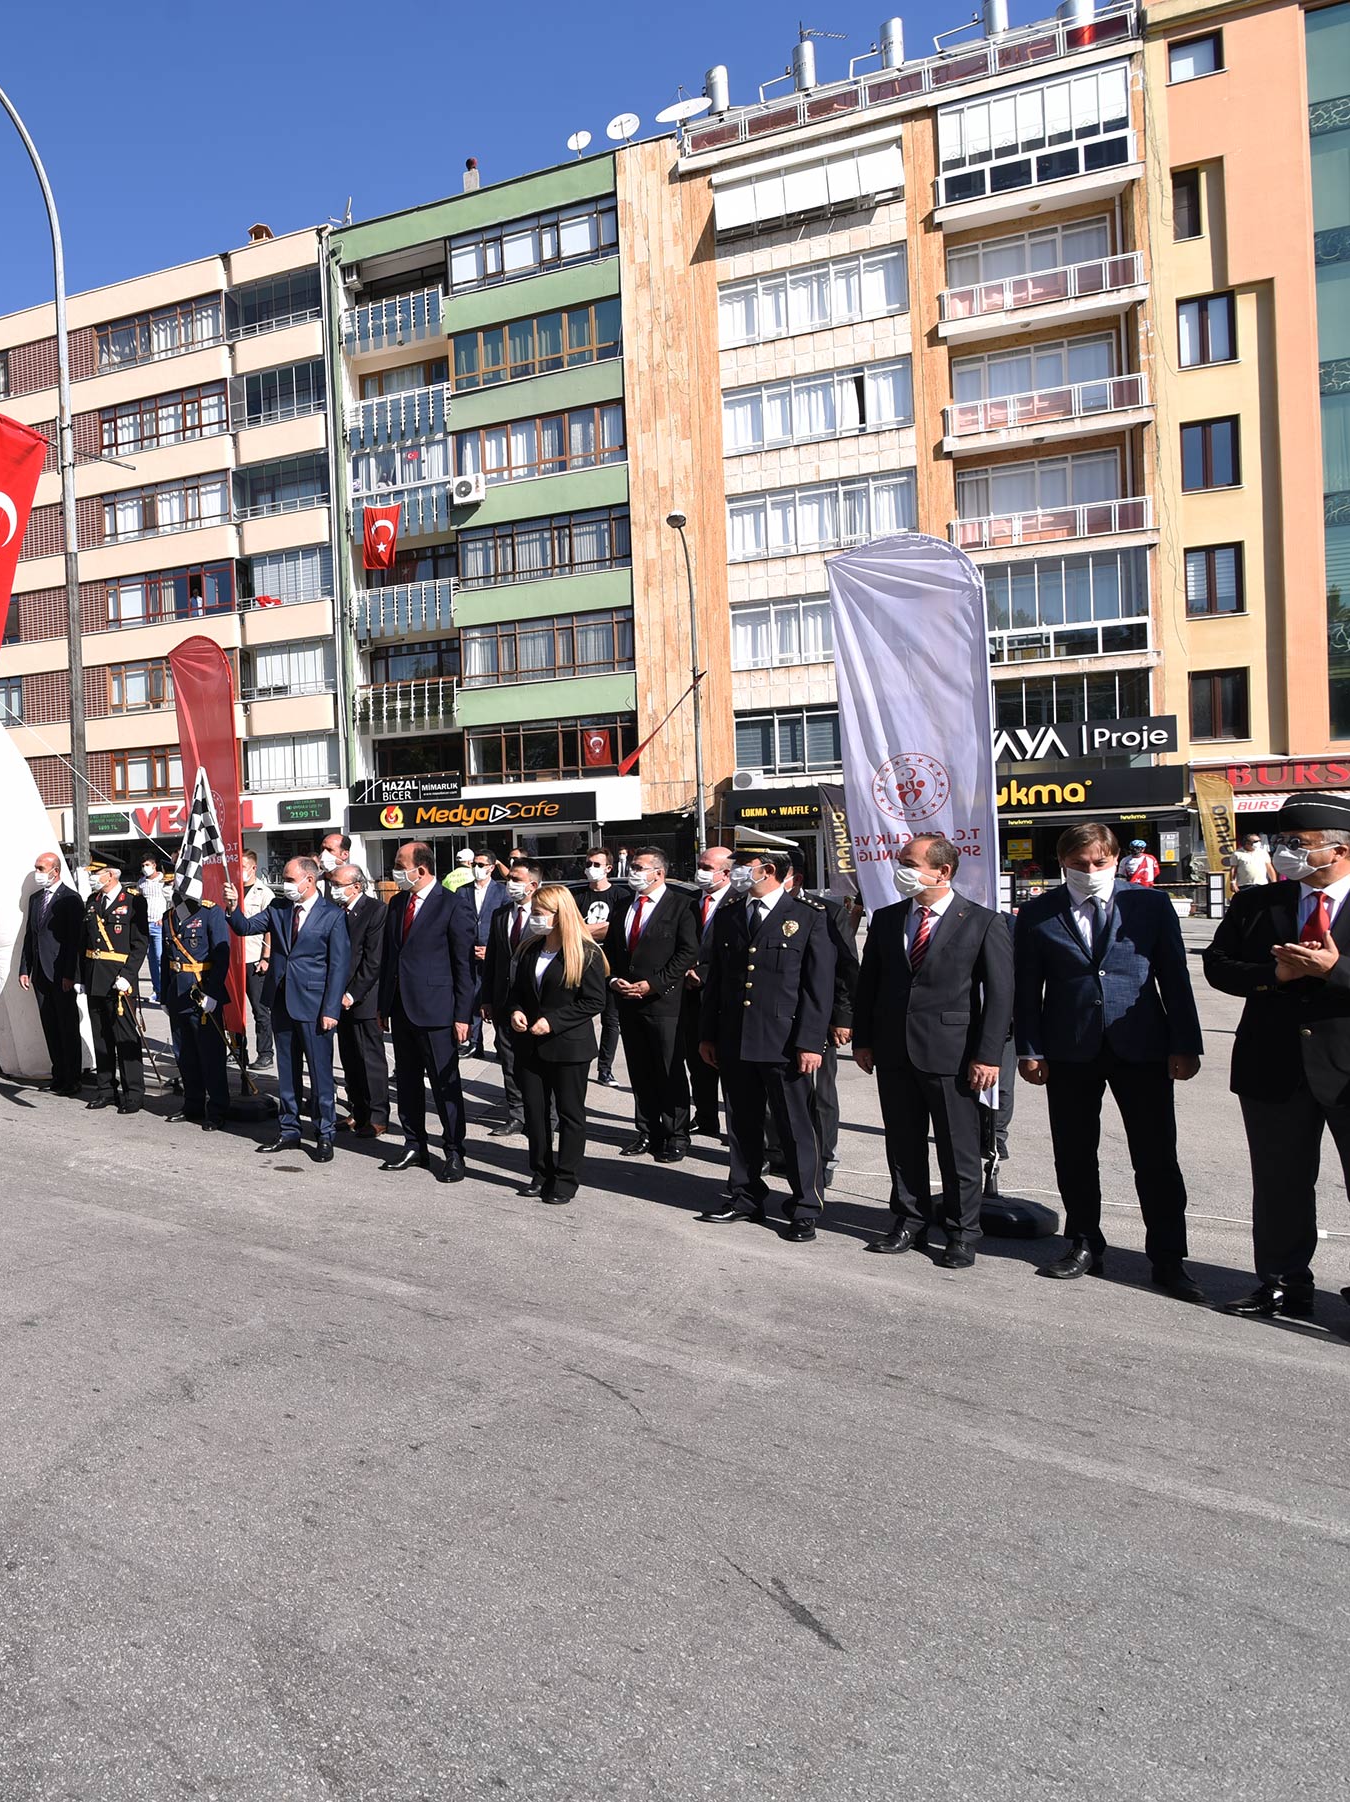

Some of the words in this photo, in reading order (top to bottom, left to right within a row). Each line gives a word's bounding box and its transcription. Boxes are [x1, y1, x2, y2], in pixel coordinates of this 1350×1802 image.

[993, 727, 1070, 761] AYA
[1093, 725, 1169, 750] Proje
[382, 780, 419, 792] HAZAL
[416, 804, 490, 826] Medya
[506, 800, 560, 819] Cafe
[741, 807, 768, 817] LOKMA
[779, 805, 810, 816] WAFFLE
